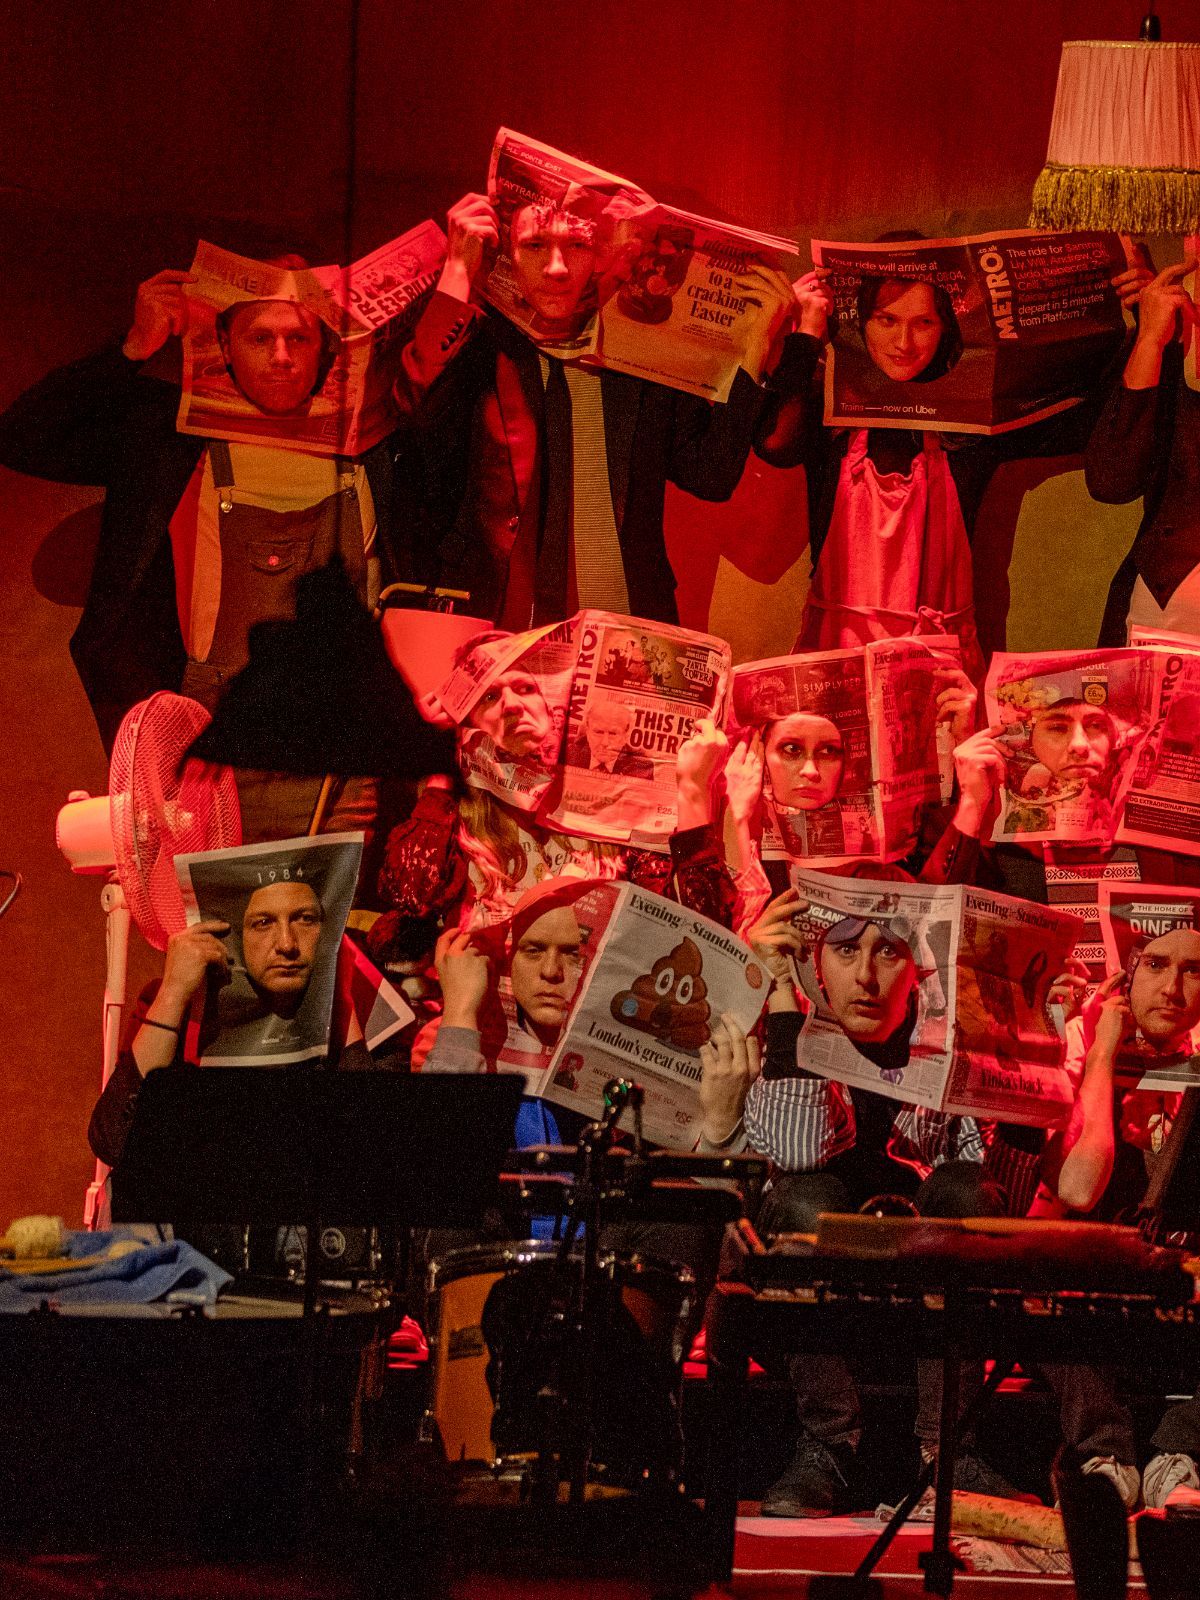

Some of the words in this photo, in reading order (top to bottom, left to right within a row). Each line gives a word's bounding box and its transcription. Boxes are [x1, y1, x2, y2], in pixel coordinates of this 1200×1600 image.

[1006, 248, 1026, 258] The
[1028, 246, 1047, 256] ride
[1049, 245, 1063, 255] for
[855, 260, 877, 270] ride
[878, 261, 896, 271] will
[897, 263, 927, 272] arrive
[928, 260, 938, 271] at
[708, 270, 722, 286] to
[723, 276, 733, 290] a
[687, 284, 748, 316] cracking
[979, 252, 1018, 339] METRO
[1018, 301, 1050, 316] depart
[1052, 300, 1060, 310] in
[1062, 299, 1068, 309] 5
[1069, 294, 1104, 307] minutes
[689, 300, 737, 328] Easter
[1019, 314, 1041, 327] from
[1042, 309, 1080, 324] Platform
[883, 404, 900, 413] now
[902, 405, 914, 413] on
[915, 404, 938, 415] Uber
[570, 629, 599, 724] METRO
[684, 668, 714, 687] TOWERS
[802, 680, 842, 693] SIMPLY
[1150, 655, 1184, 738] METRO
[633, 708, 675, 733] THIS
[677, 716, 695, 738] IS
[835, 708, 863, 719] LONDON
[1139, 797, 1186, 813] EXTRAORDINARY
[257, 867, 304, 885] 1984
[799, 882, 832, 901] Sport
[966, 894, 1009, 920] Evening
[1016, 907, 1059, 932] Standard
[629, 893, 683, 929] Evening
[689, 918, 749, 966] Standard
[1130, 918, 1172, 937] DINE
[586, 1020, 642, 1057] London's
[640, 1044, 674, 1075] great
